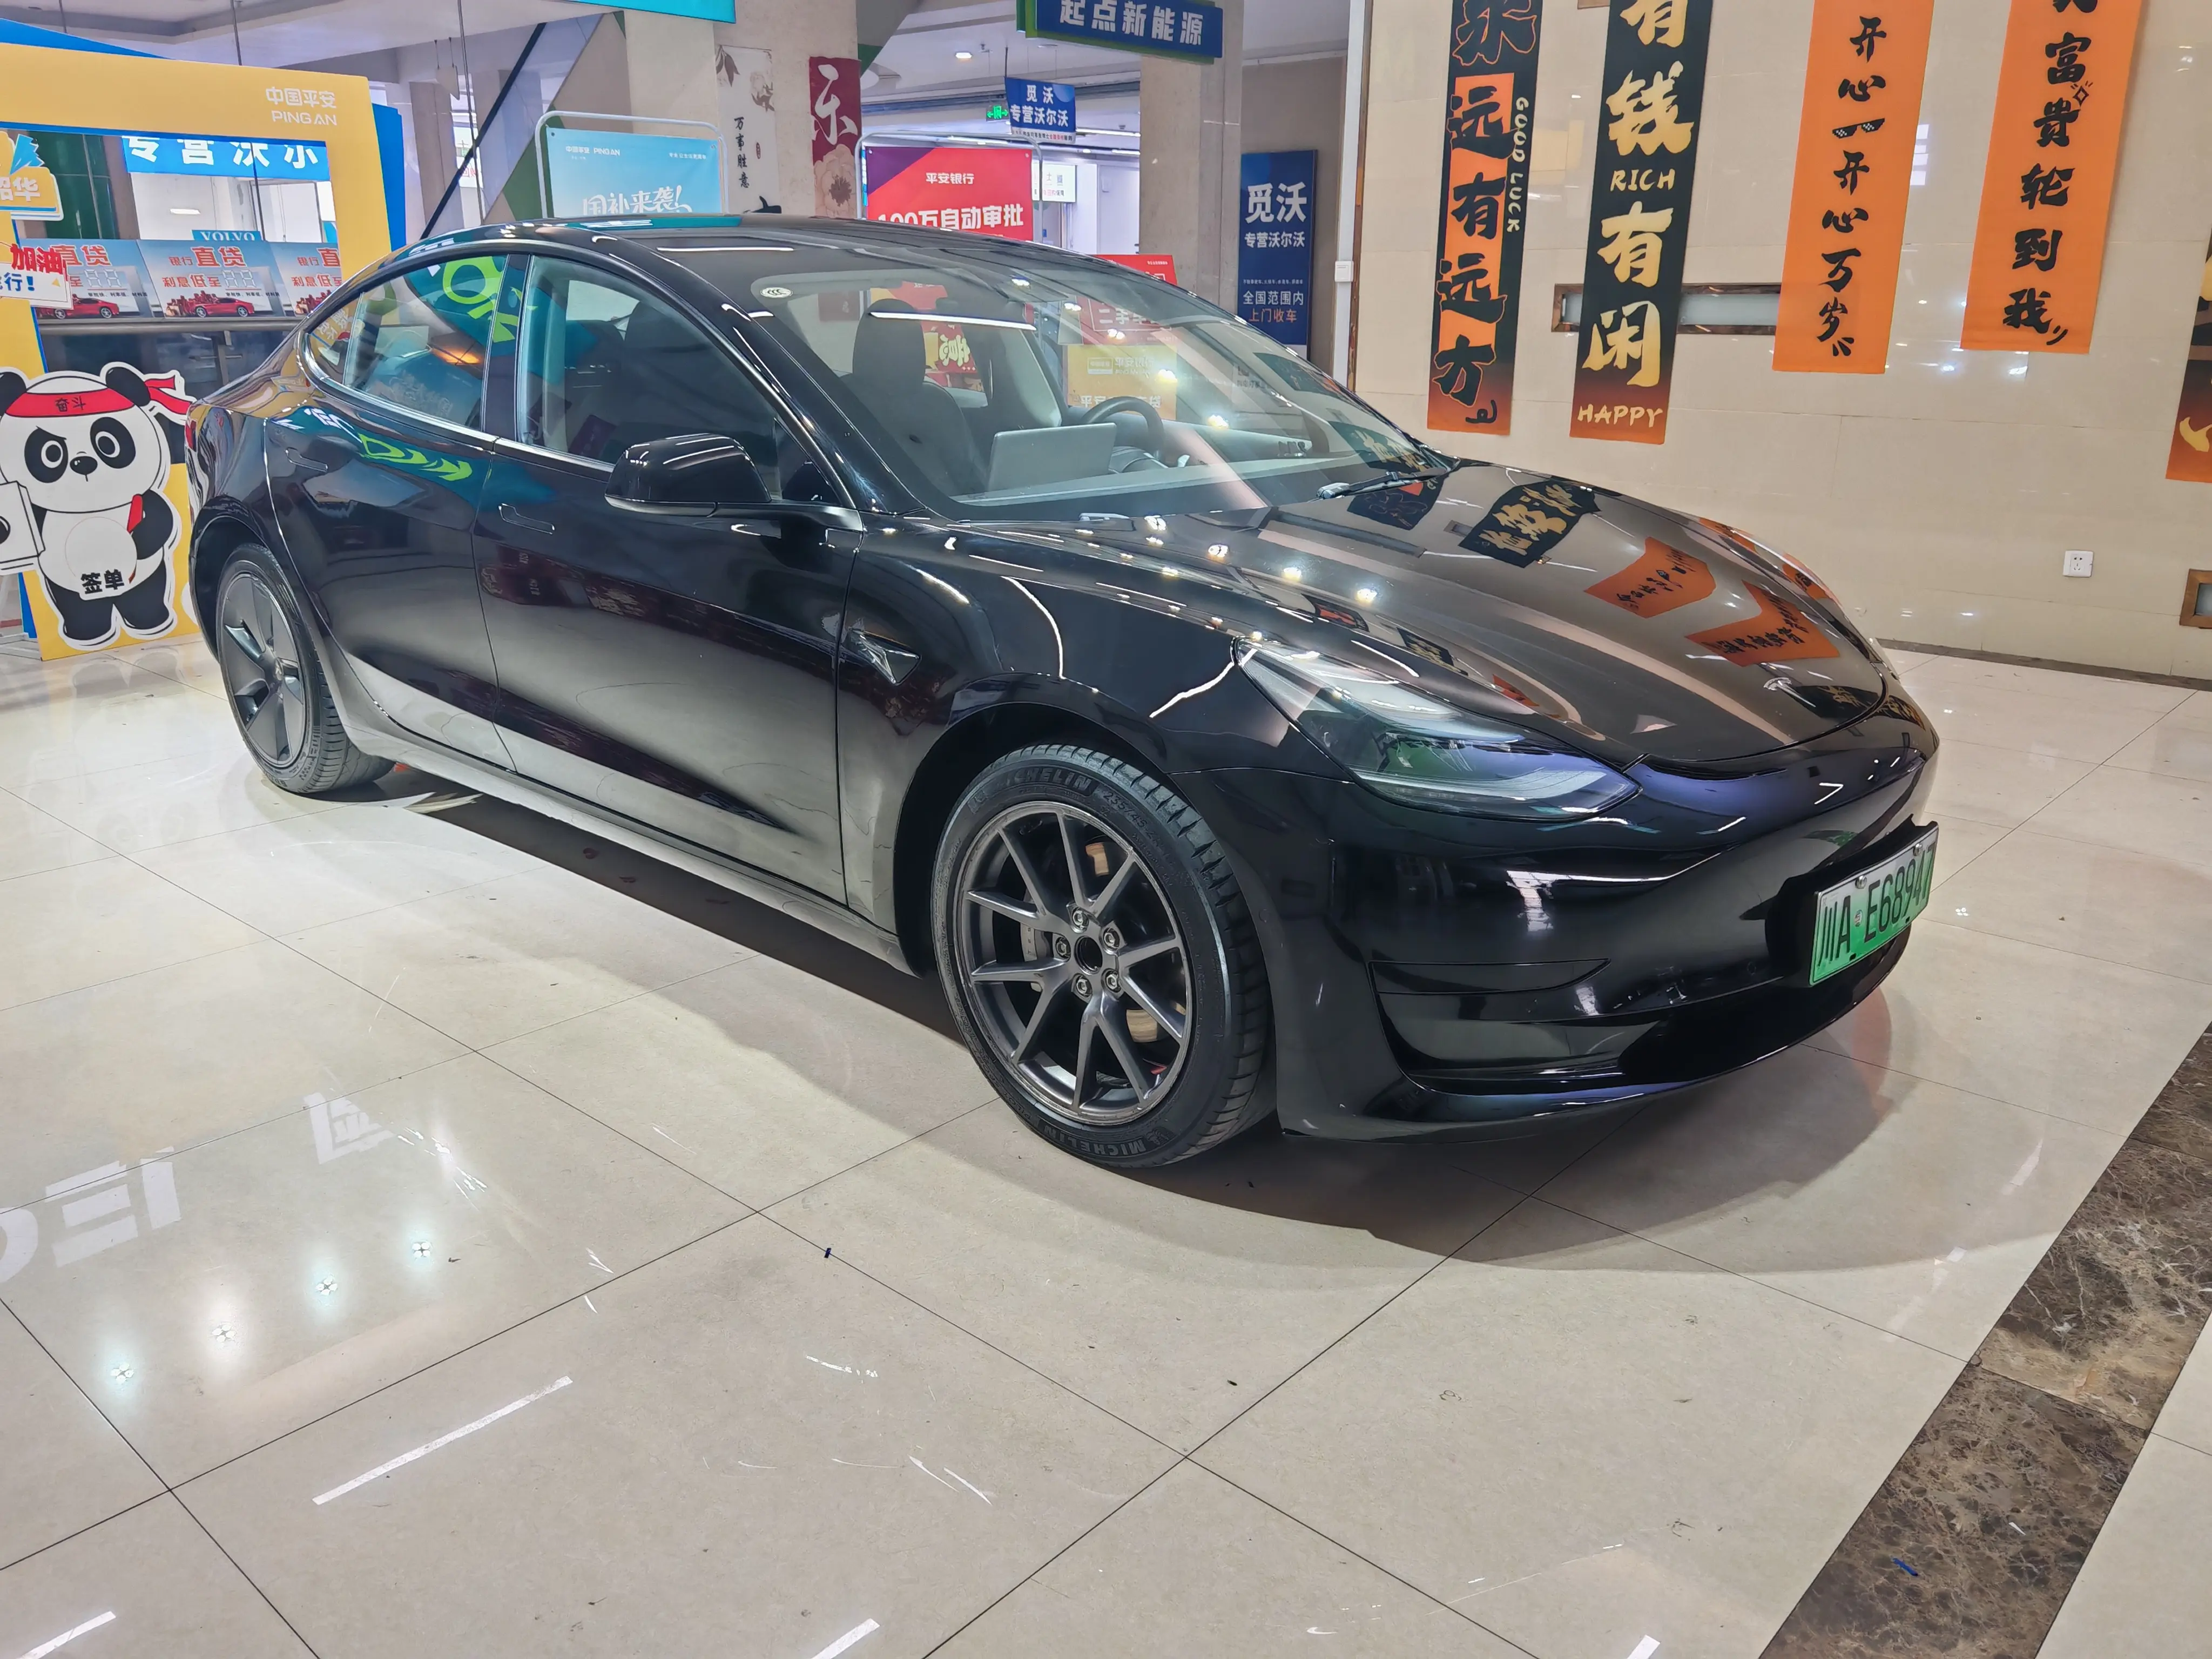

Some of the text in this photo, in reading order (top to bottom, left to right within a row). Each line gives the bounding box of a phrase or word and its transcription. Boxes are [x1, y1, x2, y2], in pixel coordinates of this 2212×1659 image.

[1060, 0, 1204, 45] 起点新能源
[265, 86, 337, 109] 中国平安
[1026, 84, 1054, 104] 觅沃
[1010, 104, 1069, 127] 专营沃尔沃
[1507, 97, 1529, 233] GOOD LUCK
[2002, 0, 2099, 334] 富贵轮到我
[926, 172, 975, 184] 平安银行
[1610, 168, 1676, 192] RICH
[1245, 181, 1307, 224] 觅沃
[199, 231, 255, 241] VOLVO
[1244, 231, 1305, 248] 专营沃尔沃
[10, 244, 64, 275] 加油
[191, 246, 247, 267] 直贷
[0, 272, 35, 292] 行!
[161, 274, 222, 288] 利息低至
[1243, 291, 1304, 306] 全国范围内
[1249, 308, 1297, 322] 上门收车
[55, 396, 86, 413] 奋斗
[1577, 403, 1664, 428] HAPPY
[80, 569, 125, 594] 签单
[1043, 1125, 1148, 1157] MICHELIN
